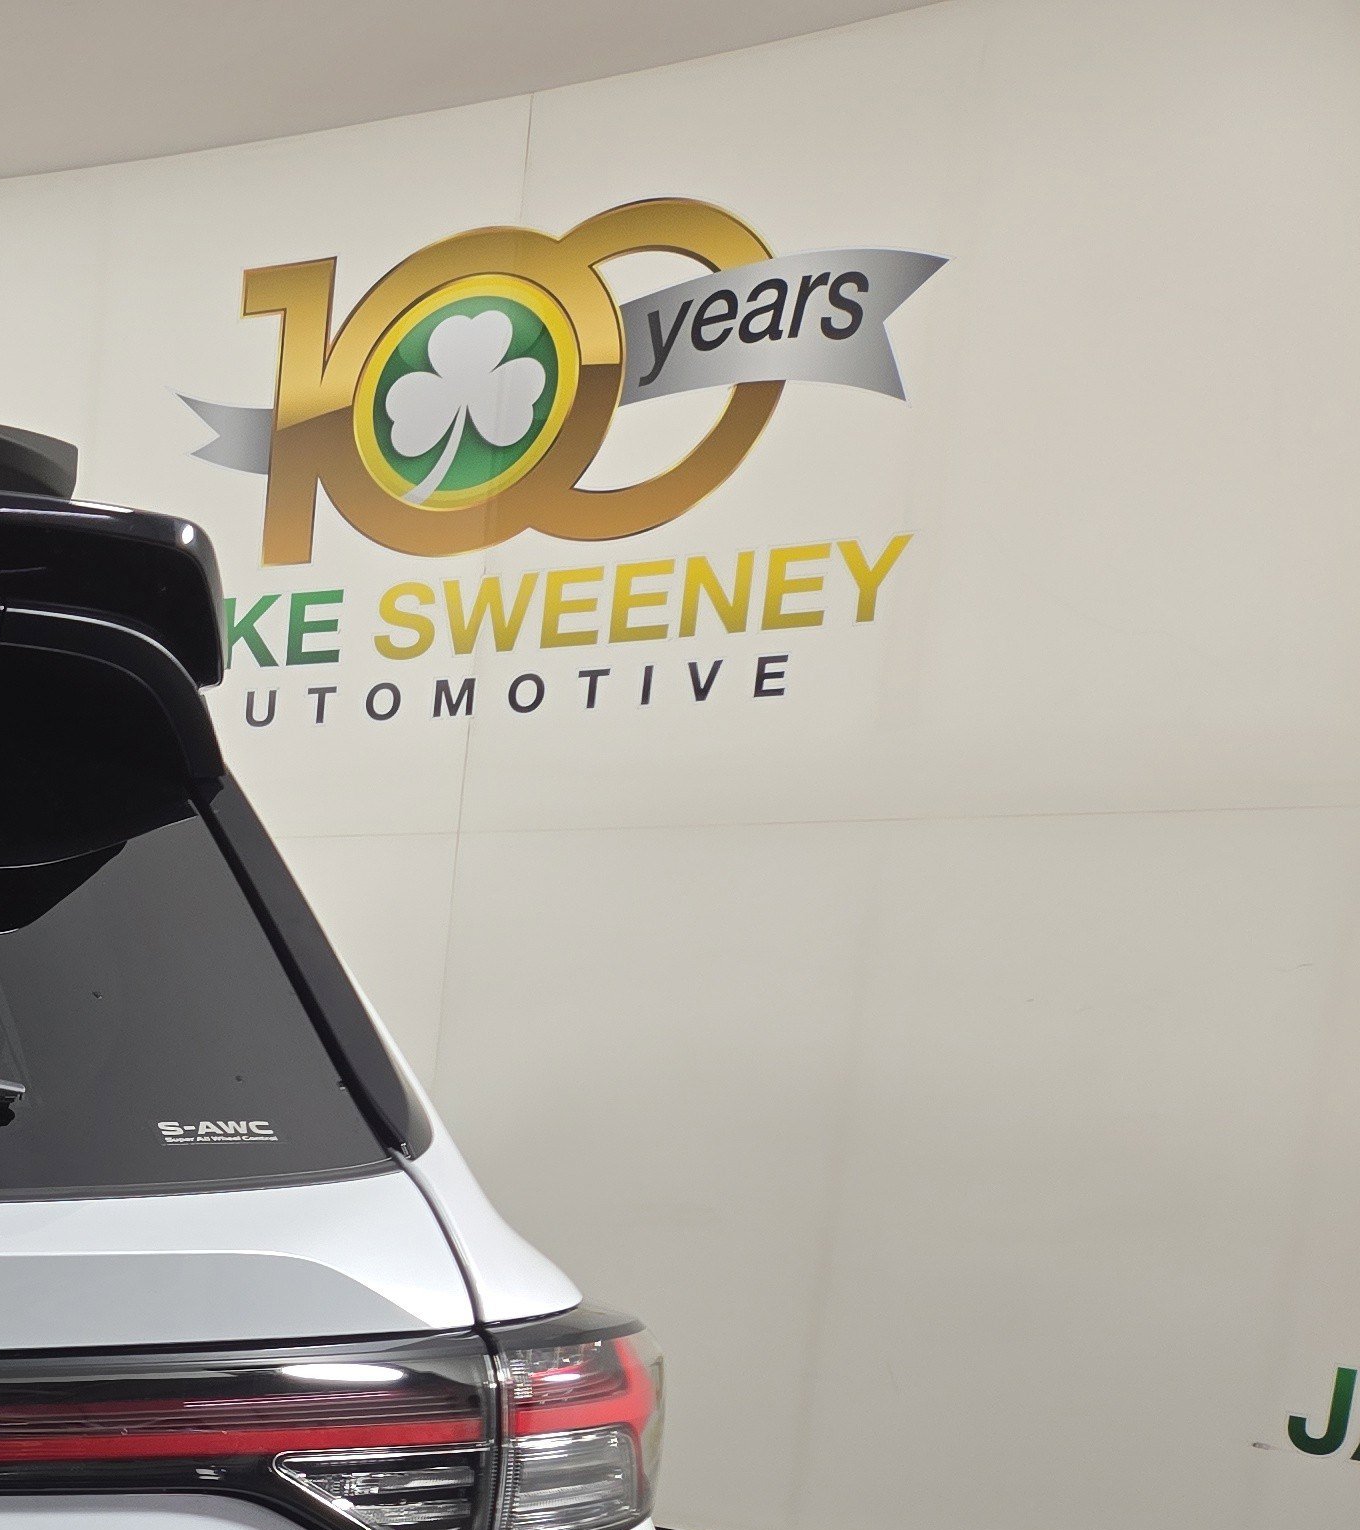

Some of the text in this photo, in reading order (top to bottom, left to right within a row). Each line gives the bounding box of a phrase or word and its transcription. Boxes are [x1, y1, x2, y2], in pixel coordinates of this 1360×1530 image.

[638, 267, 870, 387] years
[223, 533, 915, 669] KE SWEENEY
[245, 653, 789, 728] UTOMOTIVE
[158, 1121, 274, 1136] S-AWC
